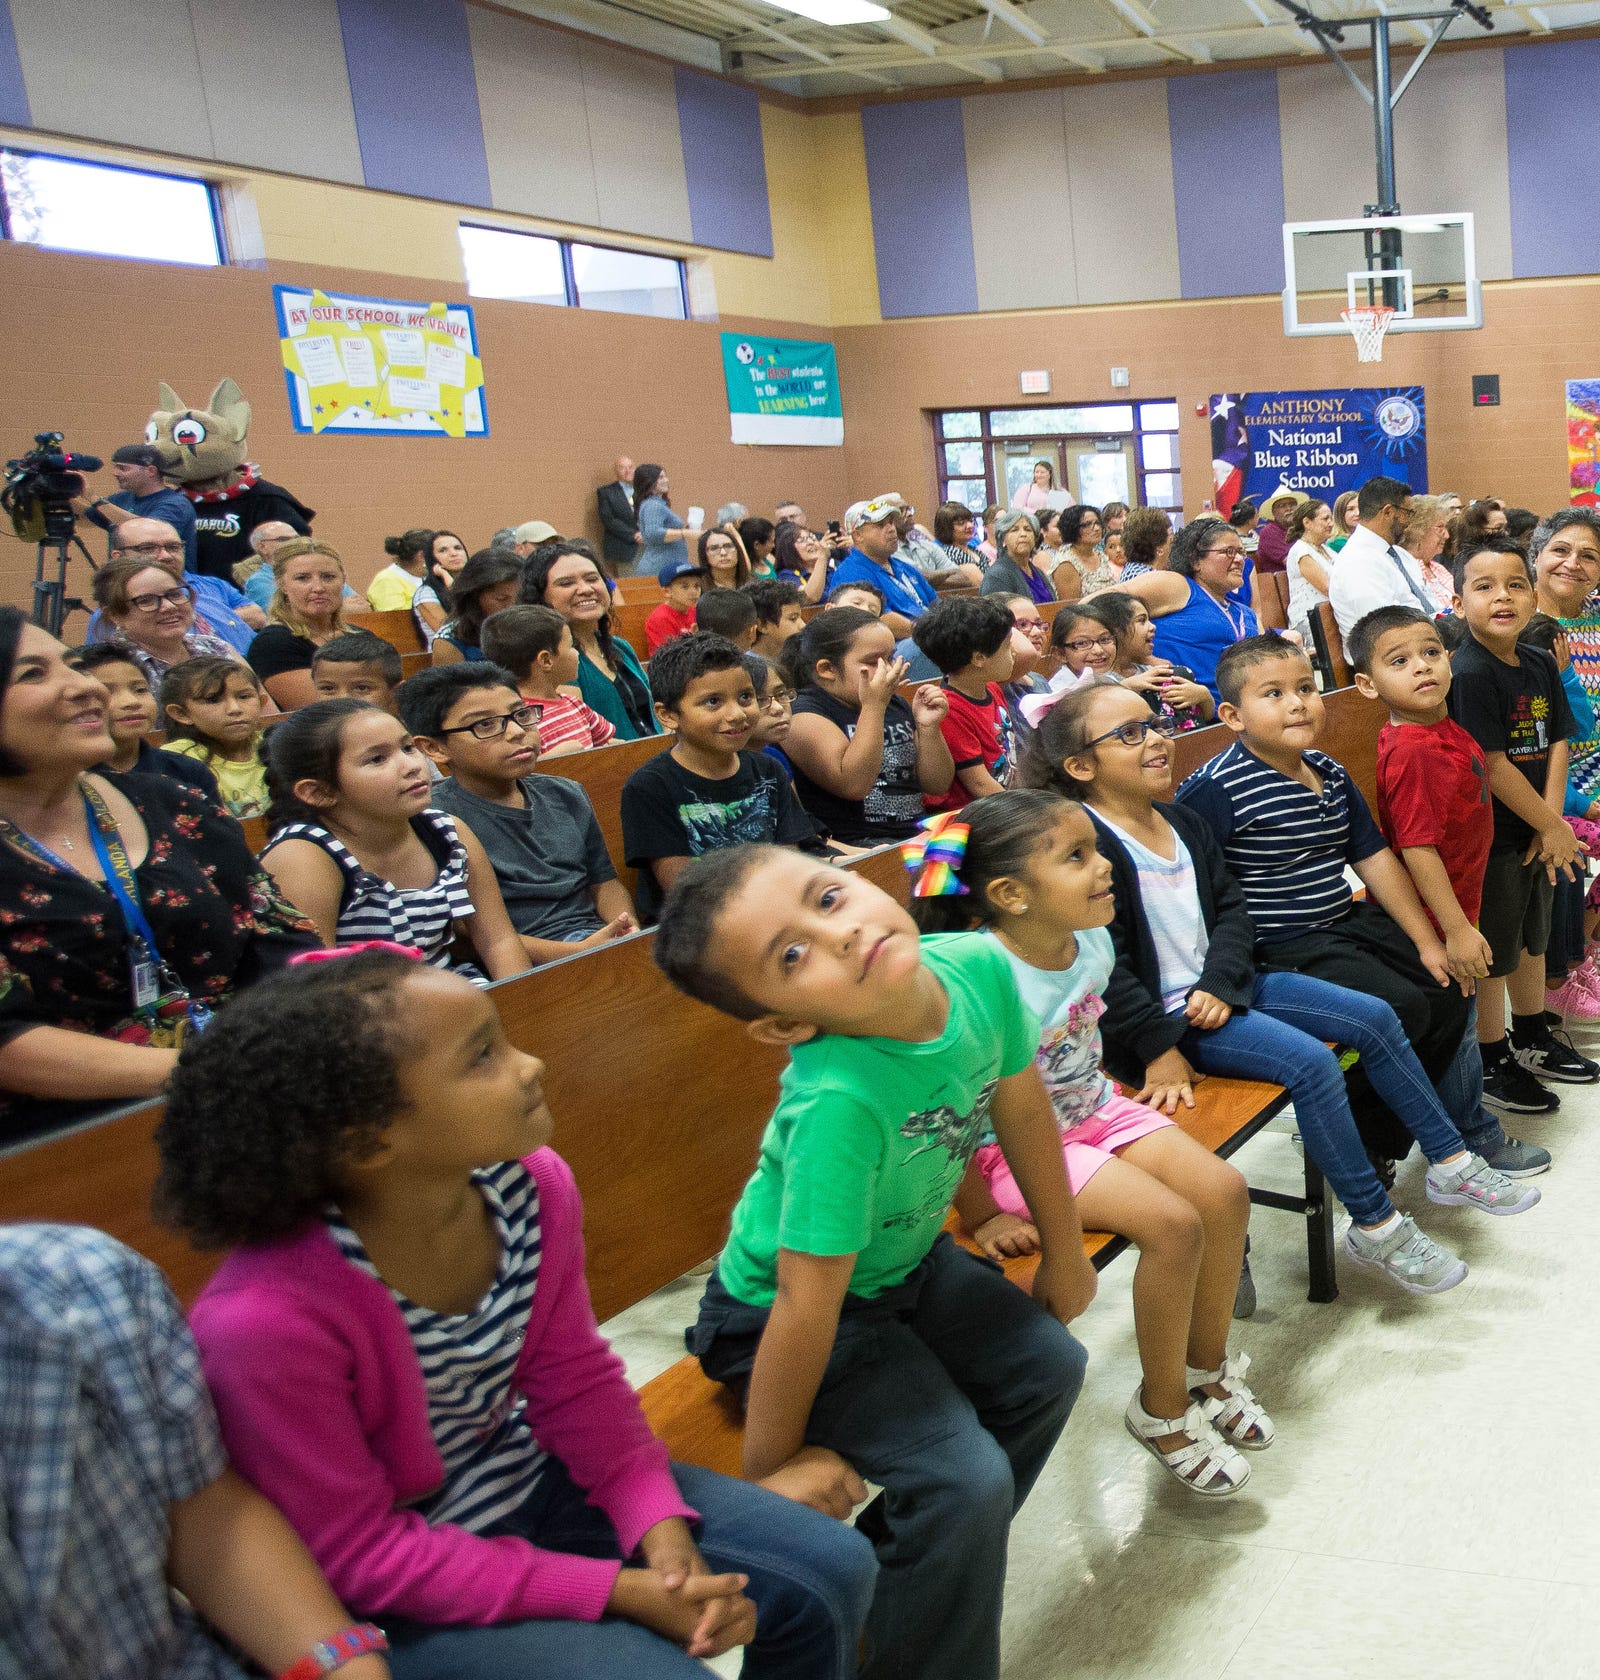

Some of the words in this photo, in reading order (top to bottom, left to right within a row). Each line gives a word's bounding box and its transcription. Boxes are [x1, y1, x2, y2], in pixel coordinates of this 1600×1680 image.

[290, 308, 307, 325] AT
[311, 307, 341, 322] OUR
[347, 308, 404, 328] SCHOOL,
[408, 315, 425, 328] WE
[427, 318, 467, 338] VALUE
[749, 367, 766, 381] The
[754, 386, 764, 397] in
[765, 384, 777, 396] the
[778, 381, 811, 393] WORLD
[813, 380, 827, 390] are
[759, 397, 808, 413] LEARNING
[1260, 399, 1345, 415] ANTHONY
[1245, 413, 1315, 426] ELEMENTARY
[1318, 411, 1363, 424] SCHOOL
[1268, 426, 1342, 447] National
[1254, 450, 1291, 468] Blue
[1295, 449, 1358, 467] Ribbon
[1279, 469, 1335, 489] School
